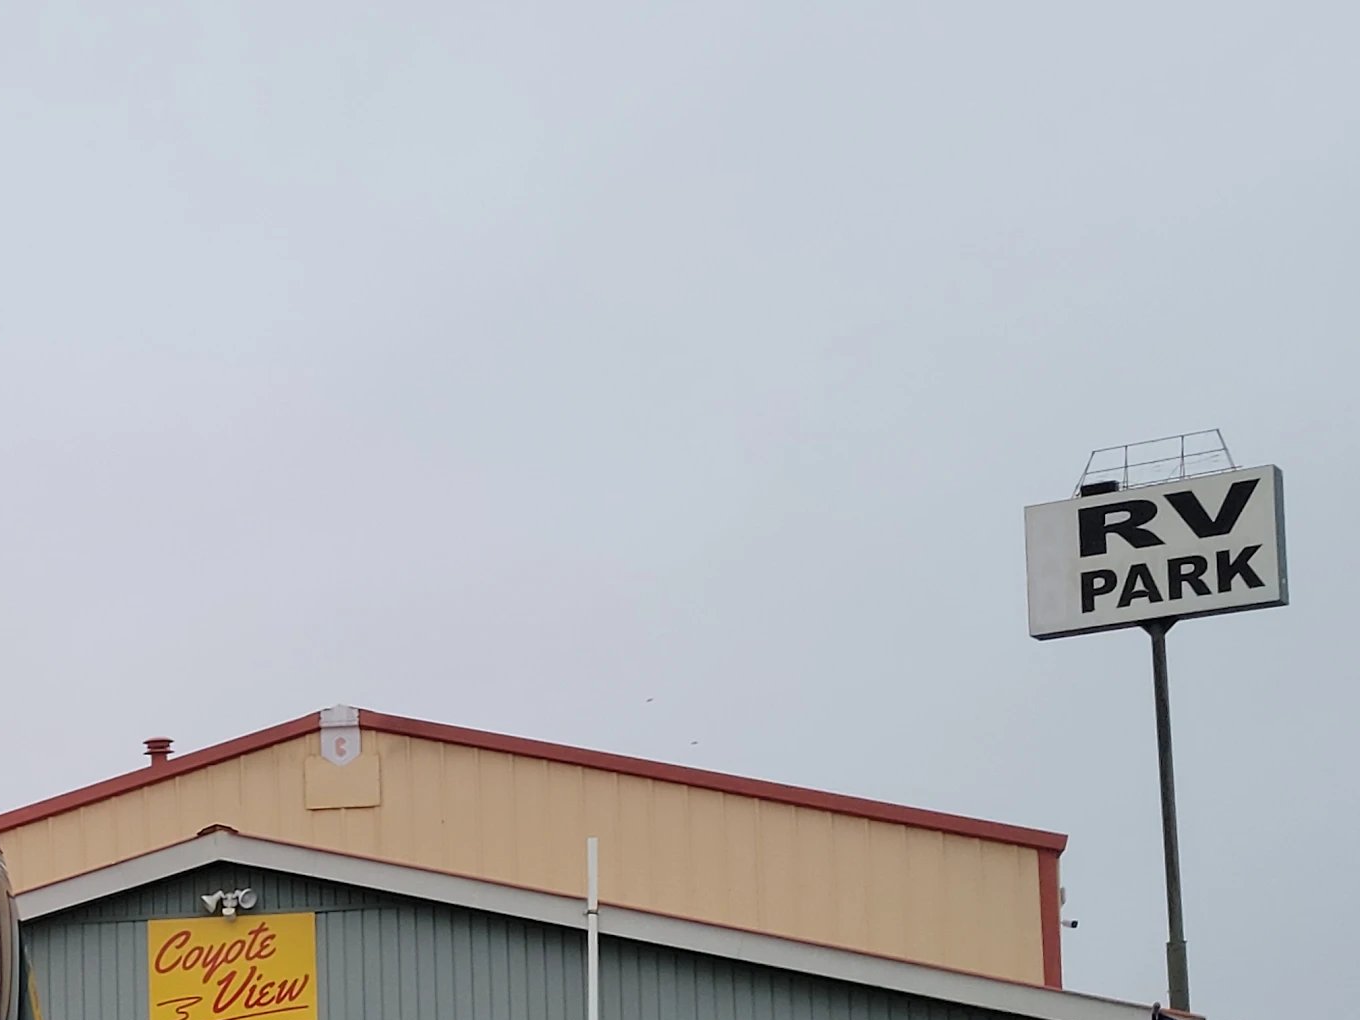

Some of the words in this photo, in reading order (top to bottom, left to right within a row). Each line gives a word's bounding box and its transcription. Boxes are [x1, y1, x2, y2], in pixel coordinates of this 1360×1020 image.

[1078, 478, 1261, 558] RV
[1080, 543, 1266, 614] PARK
[155, 922, 277, 984] Coyote
[213, 966, 309, 1013] View
